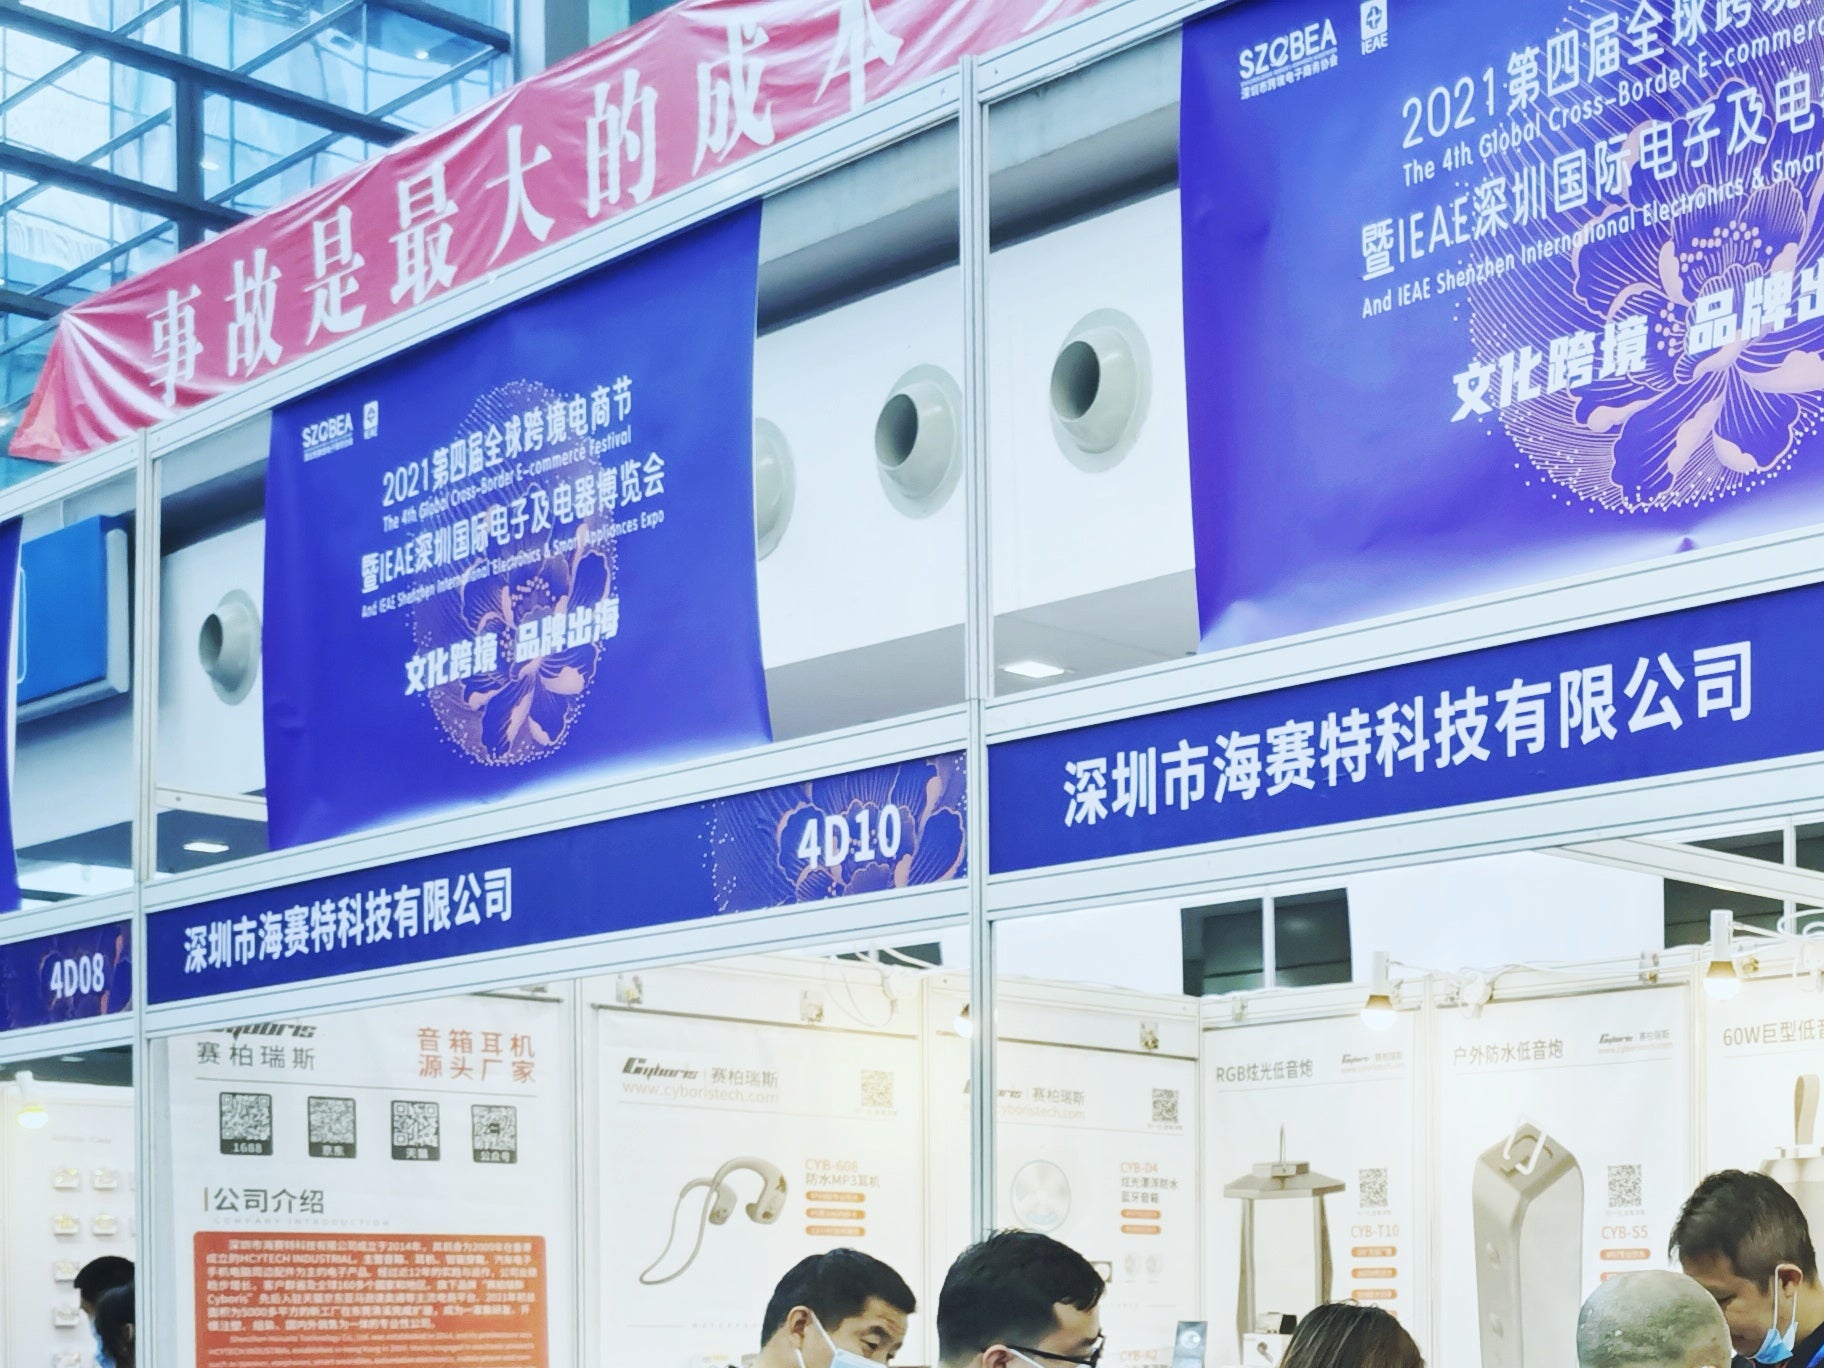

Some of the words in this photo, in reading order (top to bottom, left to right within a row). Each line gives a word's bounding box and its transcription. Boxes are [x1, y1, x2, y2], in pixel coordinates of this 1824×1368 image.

[1361, 32, 1389, 56] IEAE
[1402, 159, 1436, 188] The
[1442, 144, 1474, 173] 4th
[1479, 121, 1541, 160] Global
[1548, 61, 1690, 133] Cross-Border
[146, 0, 903, 408] 事故是最大的成本
[1362, 289, 1393, 319] And
[1397, 277, 1432, 307] IEAE
[1436, 251, 1518, 293] Shenzhen
[1521, 213, 1637, 265] International
[1642, 175, 1745, 226] Electronics
[1751, 168, 1768, 190] &
[1450, 314, 1649, 422] 文化跨境
[382, 375, 633, 508] 2021第四届全球跨境电商节
[382, 514, 401, 533] The
[419, 492, 450, 526] Global
[451, 468, 514, 512] Cross-Border
[516, 442, 586, 485] E-commerce
[589, 423, 632, 456] Festival
[361, 451, 665, 595] 暨IEAE深圳国际电子及电器博览会
[640, 509, 665, 534] Expo
[404, 632, 498, 697] 文化跨境
[515, 596, 620, 663] 品牌出海
[1062, 641, 1756, 831] 深圳市海赛特科技有限公司
[796, 802, 904, 871] 4D10
[183, 867, 514, 976] 深圳市海赛特科技有限公司
[48, 950, 106, 1002] 4D08
[197, 1041, 317, 1071] 赛柏瑞斯
[417, 1026, 535, 1058] 音箱耳机
[1454, 1038, 1564, 1066] 户外防水低音炮
[418, 1054, 536, 1084] 源头厂家
[622, 1056, 700, 1081] Cyboris
[711, 1066, 779, 1088] 赛柏瑞斯
[1216, 1058, 1314, 1084] RGB炫光低音炮
[622, 1082, 780, 1104] www.cyboristech.com
[1032, 1087, 1086, 1106] 赛柏瑞斯
[232, 1141, 264, 1155] 1688
[213, 1186, 326, 1215] 公司介绍
[1350, 1223, 1400, 1239] CYB-T10
[1601, 1224, 1649, 1241] CYB-S5
